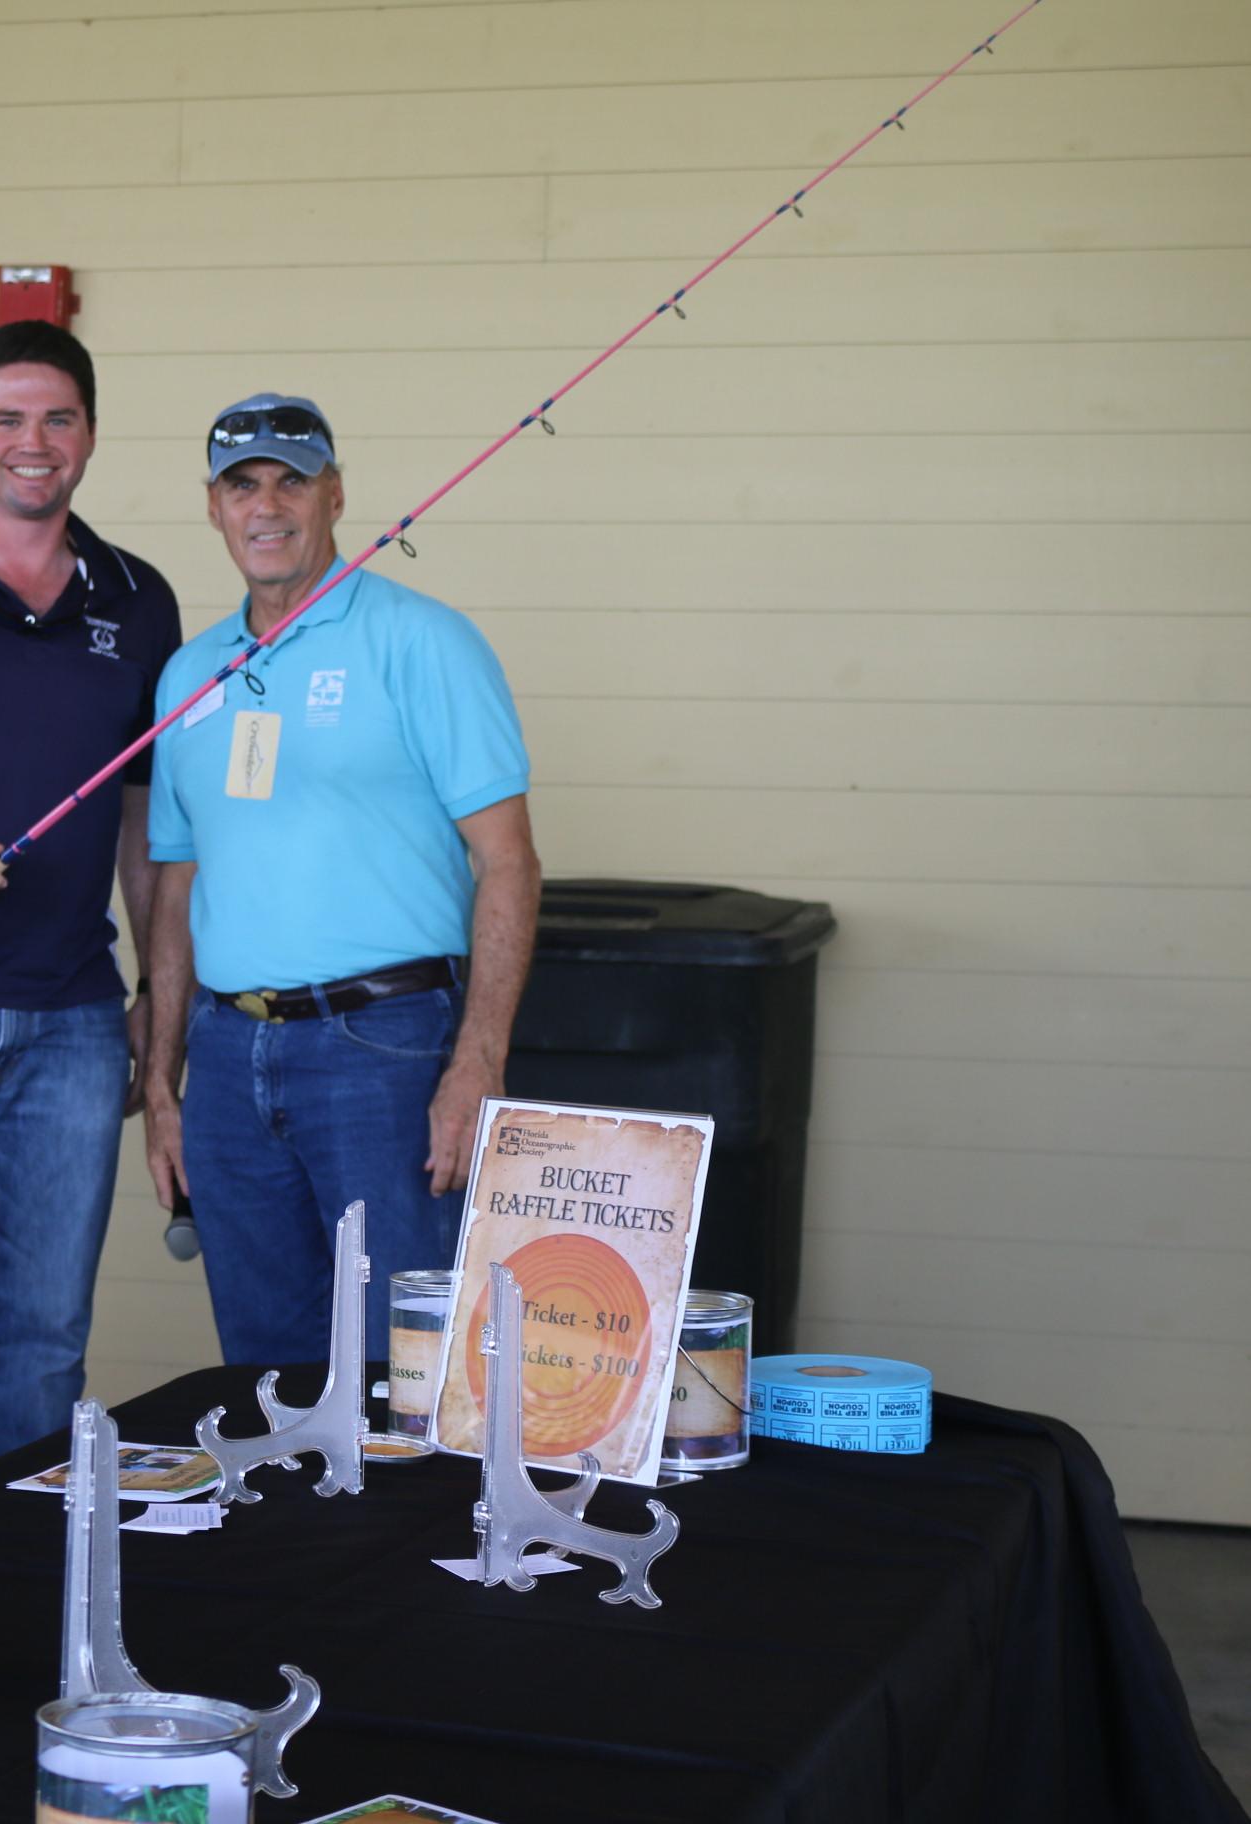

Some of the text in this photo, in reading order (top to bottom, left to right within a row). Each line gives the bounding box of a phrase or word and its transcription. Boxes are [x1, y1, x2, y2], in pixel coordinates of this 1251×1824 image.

[522, 1128, 549, 1139] Florida
[521, 1138, 577, 1152] Oceanographic
[519, 1147, 546, 1159] Society
[540, 1165, 632, 1197] BUCKET
[489, 1190, 675, 1233] RAFFLE TICKETS
[594, 1310, 631, 1334] $10
[521, 1344, 574, 1369] ickets
[591, 1353, 640, 1378] $100
[772, 1403, 790, 1412] THIS
[776, 1398, 809, 1408] COUPON
[824, 1409, 868, 1417] KEEP THIS
[900, 1409, 920, 1417] KEEP
[884, 1439, 916, 1450] TICKET
